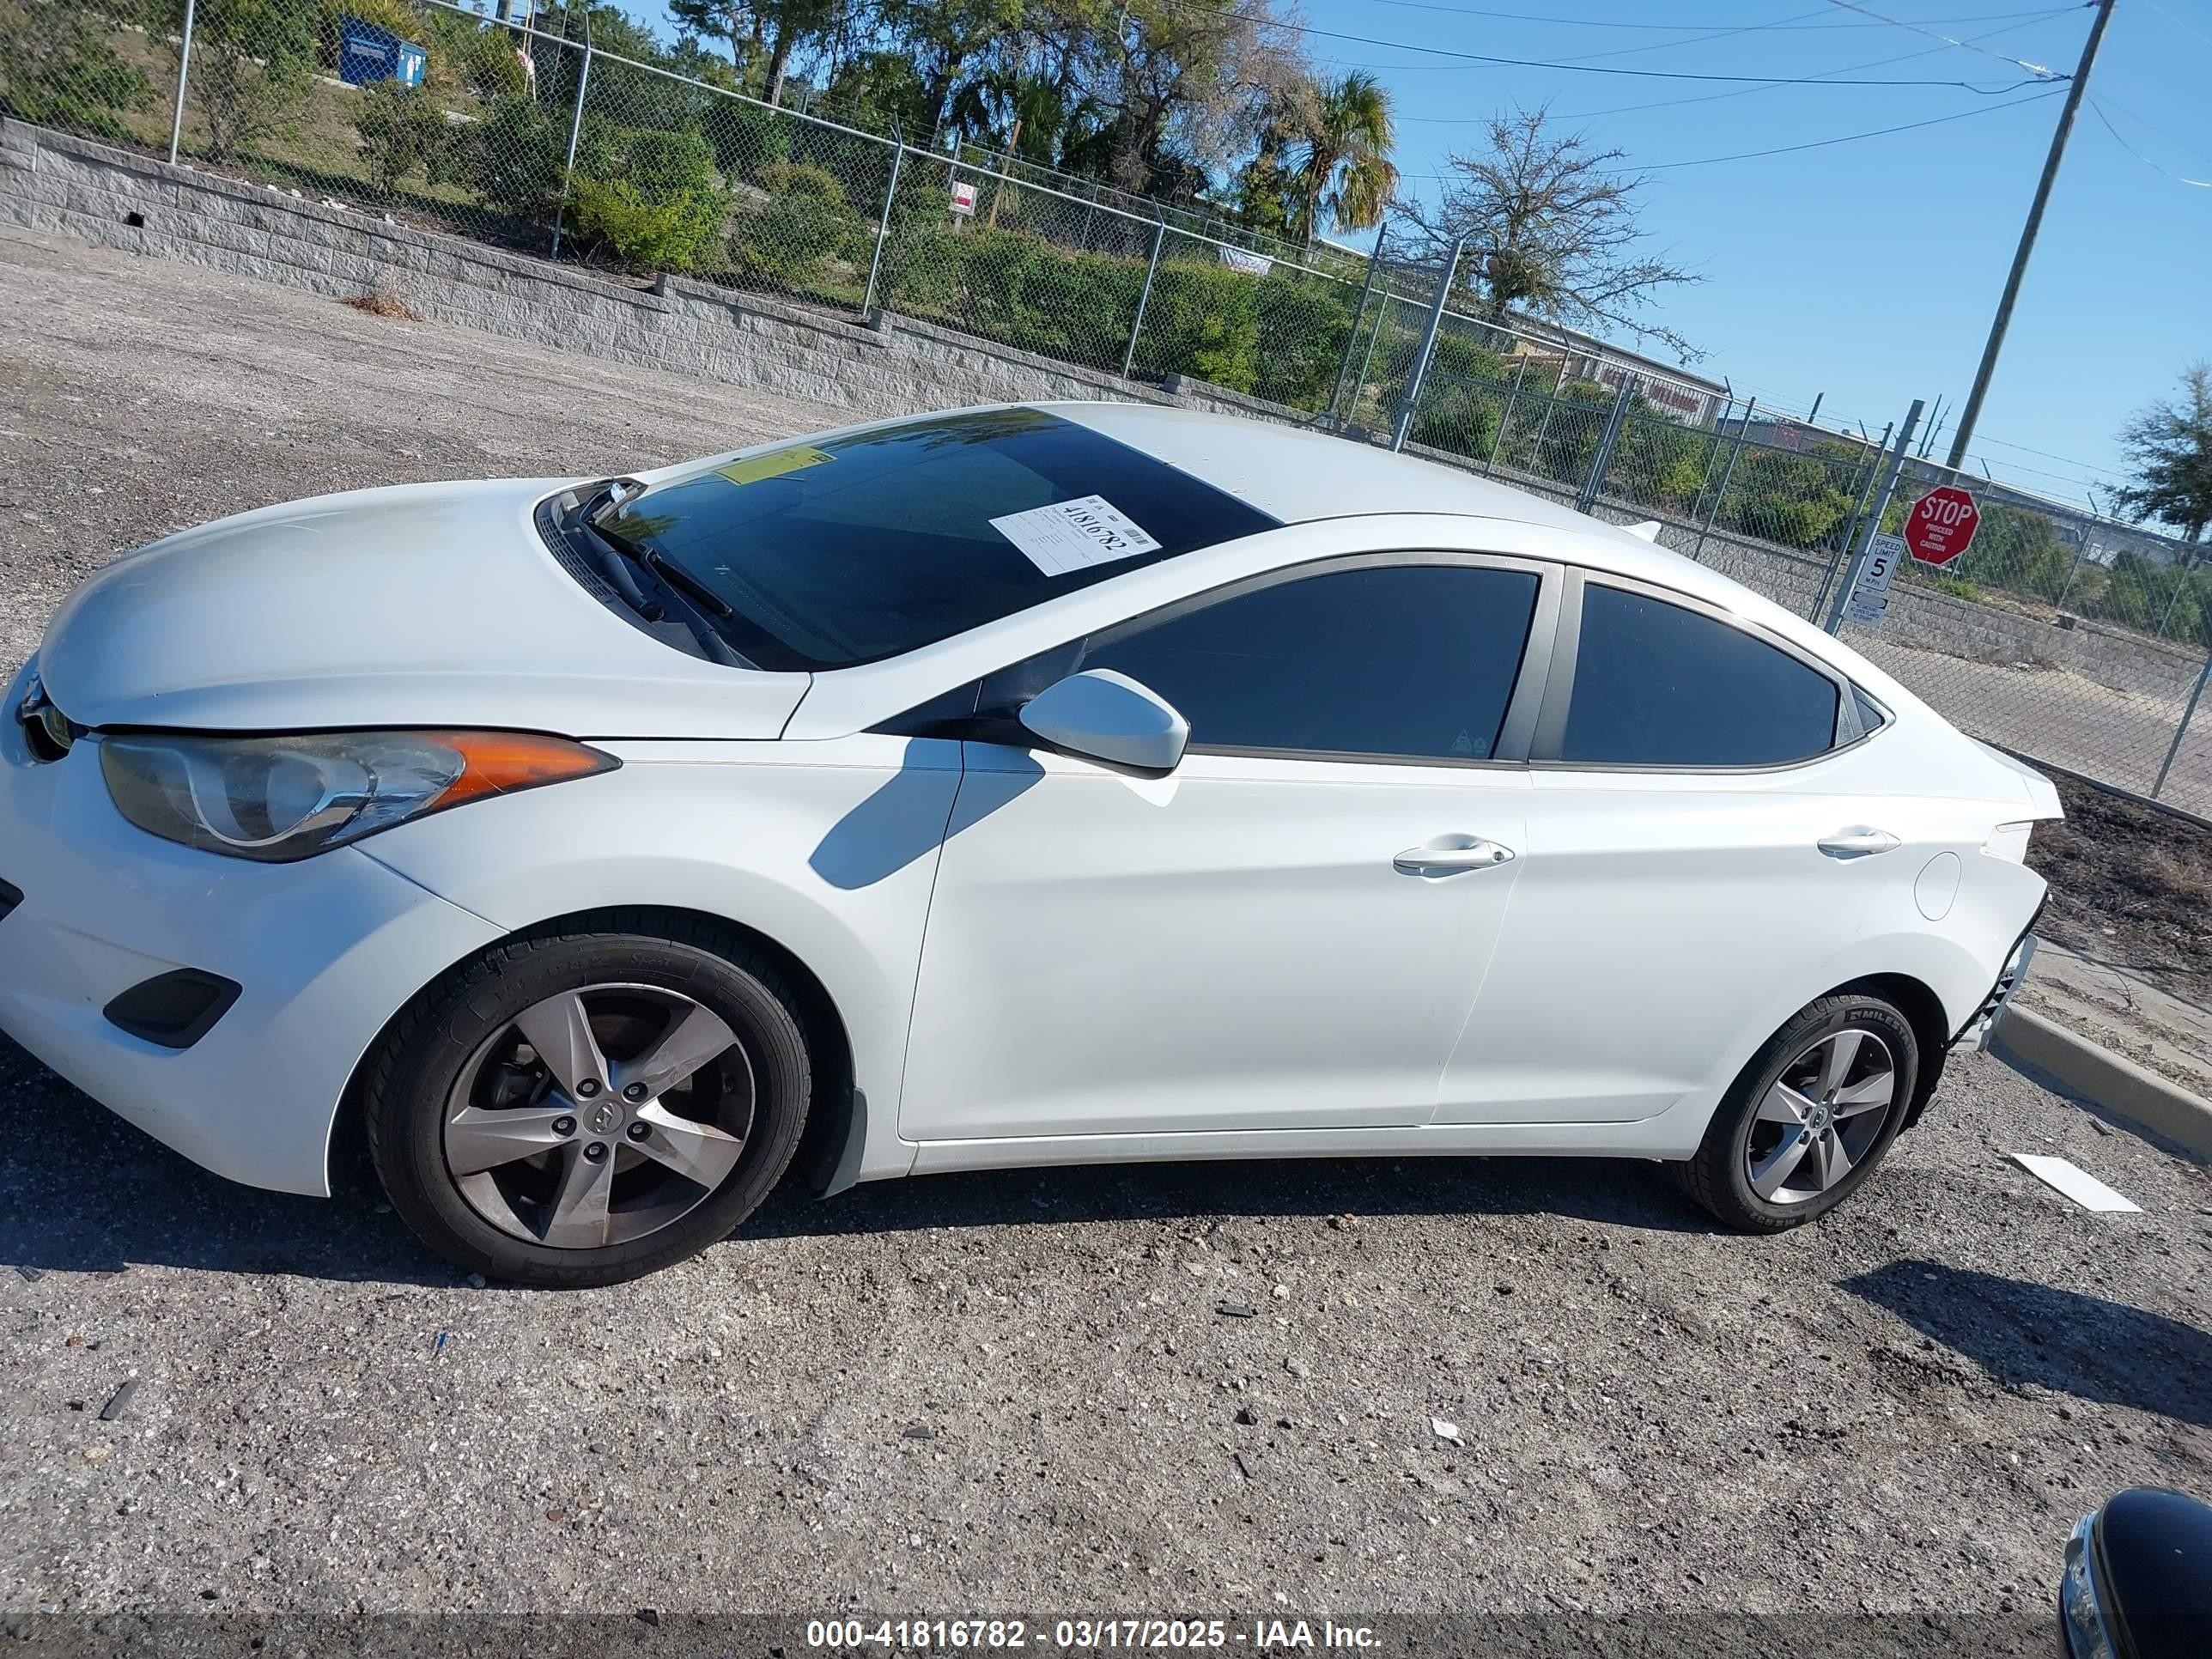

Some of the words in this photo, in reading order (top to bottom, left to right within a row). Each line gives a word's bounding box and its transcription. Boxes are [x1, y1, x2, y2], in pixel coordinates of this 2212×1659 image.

[1921, 496, 1972, 526] STOP
[1063, 507, 1127, 550] 41816782
[1925, 523, 1954, 536] PROCEED
[1929, 532, 1944, 543] WITH
[1875, 539, 1900, 551] SPEED
[1920, 539, 1947, 552] CAUTION
[1875, 548, 1896, 558] LIMIT
[1870, 558, 1887, 577] 5
[1862, 1010, 1913, 1056] MILESTAR
